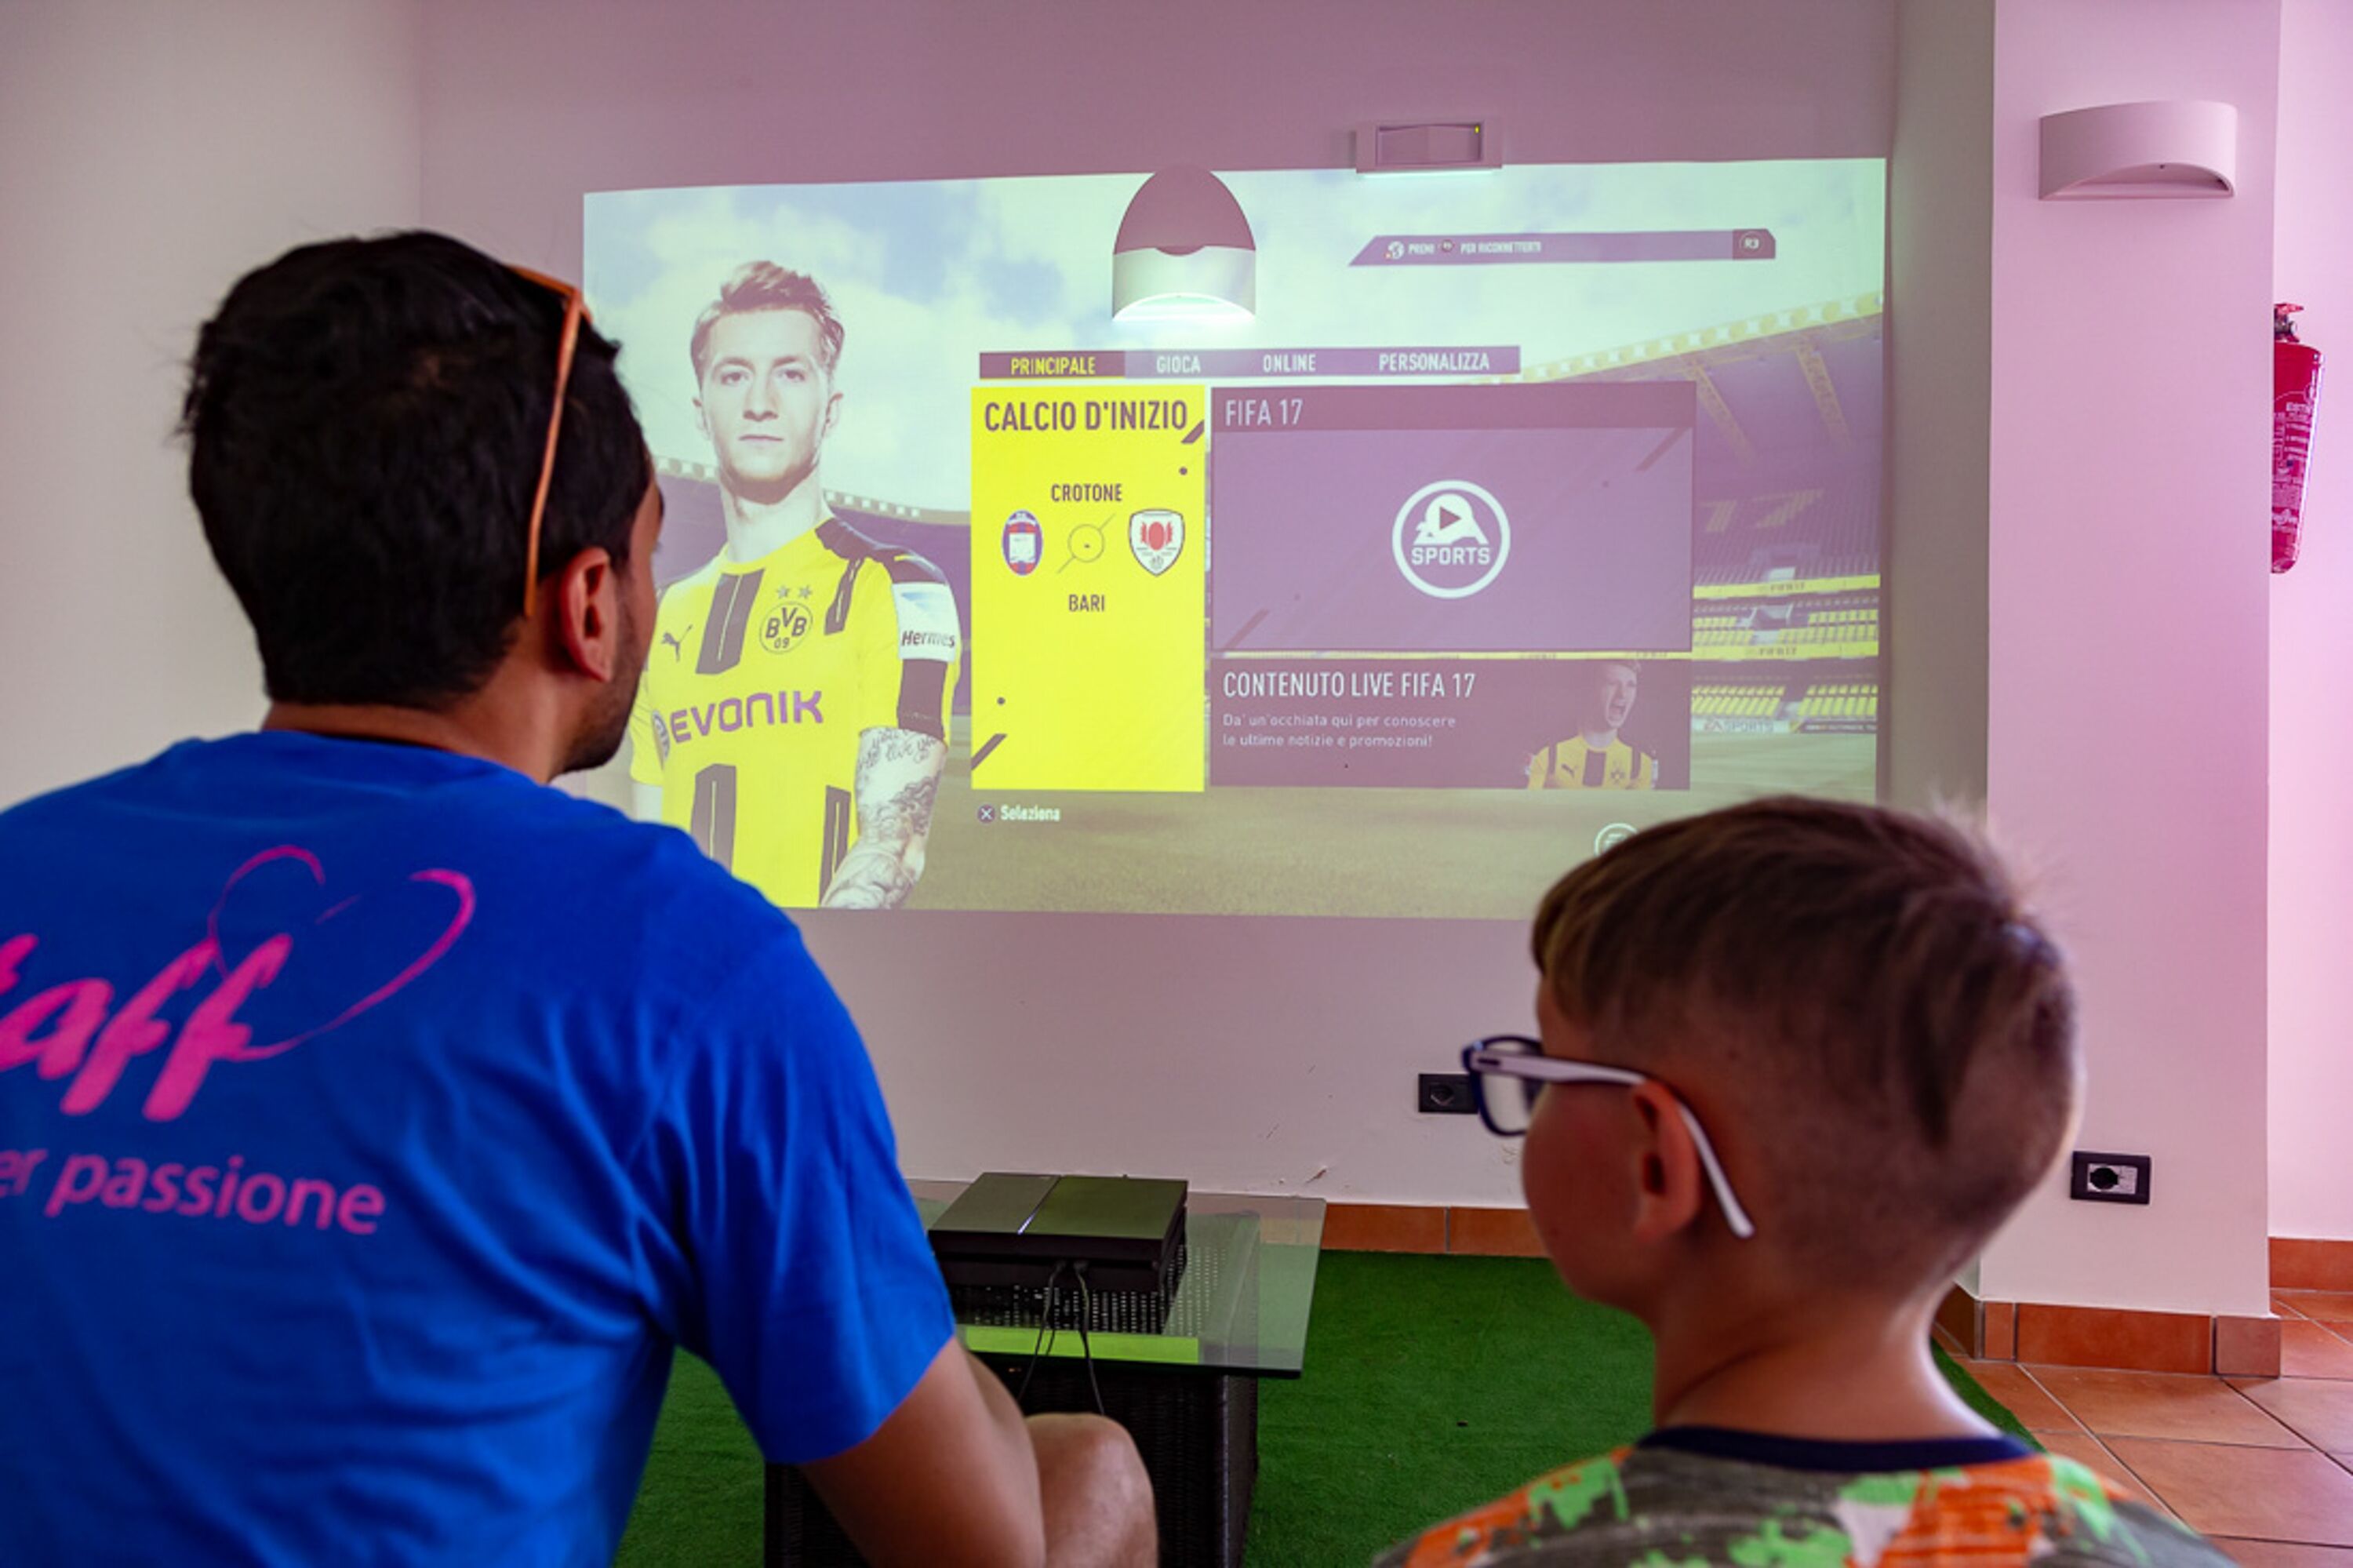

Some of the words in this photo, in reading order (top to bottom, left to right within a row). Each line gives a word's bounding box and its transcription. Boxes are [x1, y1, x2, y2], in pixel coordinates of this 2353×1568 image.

[1010, 356, 1096, 376] PRINCIPALE
[1156, 355, 1201, 373] GIOCA
[1263, 354, 1316, 373] ONLINE
[1378, 351, 1489, 372] PERSONALIZZA
[984, 402, 1076, 431] CALCIO
[1085, 399, 1187, 431] D'INIZIO
[1225, 399, 1271, 426] FIFA
[1278, 398, 1304, 424] 17
[1051, 483, 1123, 502] CROTONE
[1412, 547, 1490, 565] SPORTS
[1068, 594, 1106, 612] BARI
[901, 629, 956, 648] Hermes
[1223, 671, 1345, 698] CONTENUTO
[1351, 671, 1394, 697] LIVE
[1401, 672, 1446, 697] FIFA
[1452, 672, 1476, 698] 17
[671, 689, 824, 744] EVONIK
[1331, 712, 1353, 730] qui
[1356, 715, 1379, 730] per
[1384, 715, 1456, 728] conoscere
[1240, 734, 1285, 747] ultime
[1289, 734, 1334, 746] notizie
[1337, 737, 1344, 747] e
[1349, 735, 1432, 748] promozioni!
[1000, 804, 1061, 821] Seleziona
[45, 1153, 386, 1235] passione
